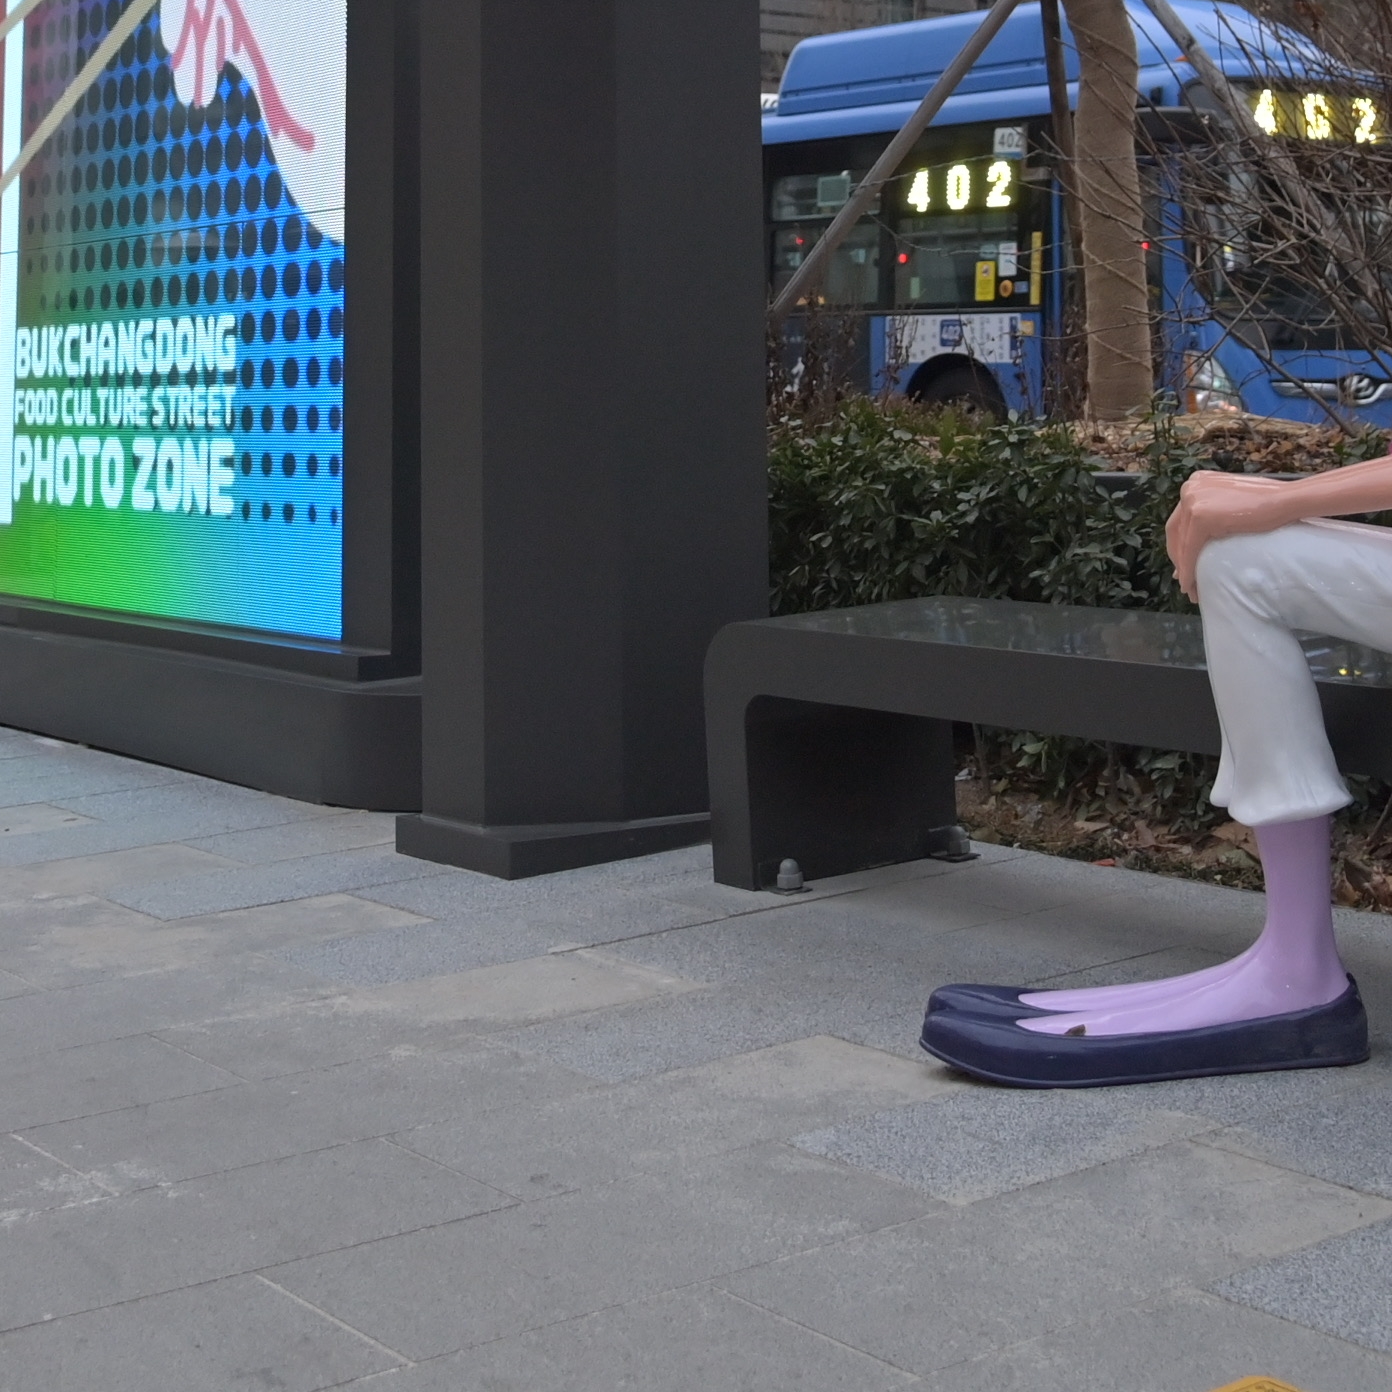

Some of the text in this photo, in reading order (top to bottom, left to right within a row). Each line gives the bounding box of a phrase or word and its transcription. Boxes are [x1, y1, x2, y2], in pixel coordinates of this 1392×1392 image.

[907, 160, 1012, 213] 402
[16, 313, 237, 379] BUKCHANGDONG
[15, 385, 237, 430] FOOD CULTURE STREET
[13, 435, 235, 517] PHOTO ZONE
